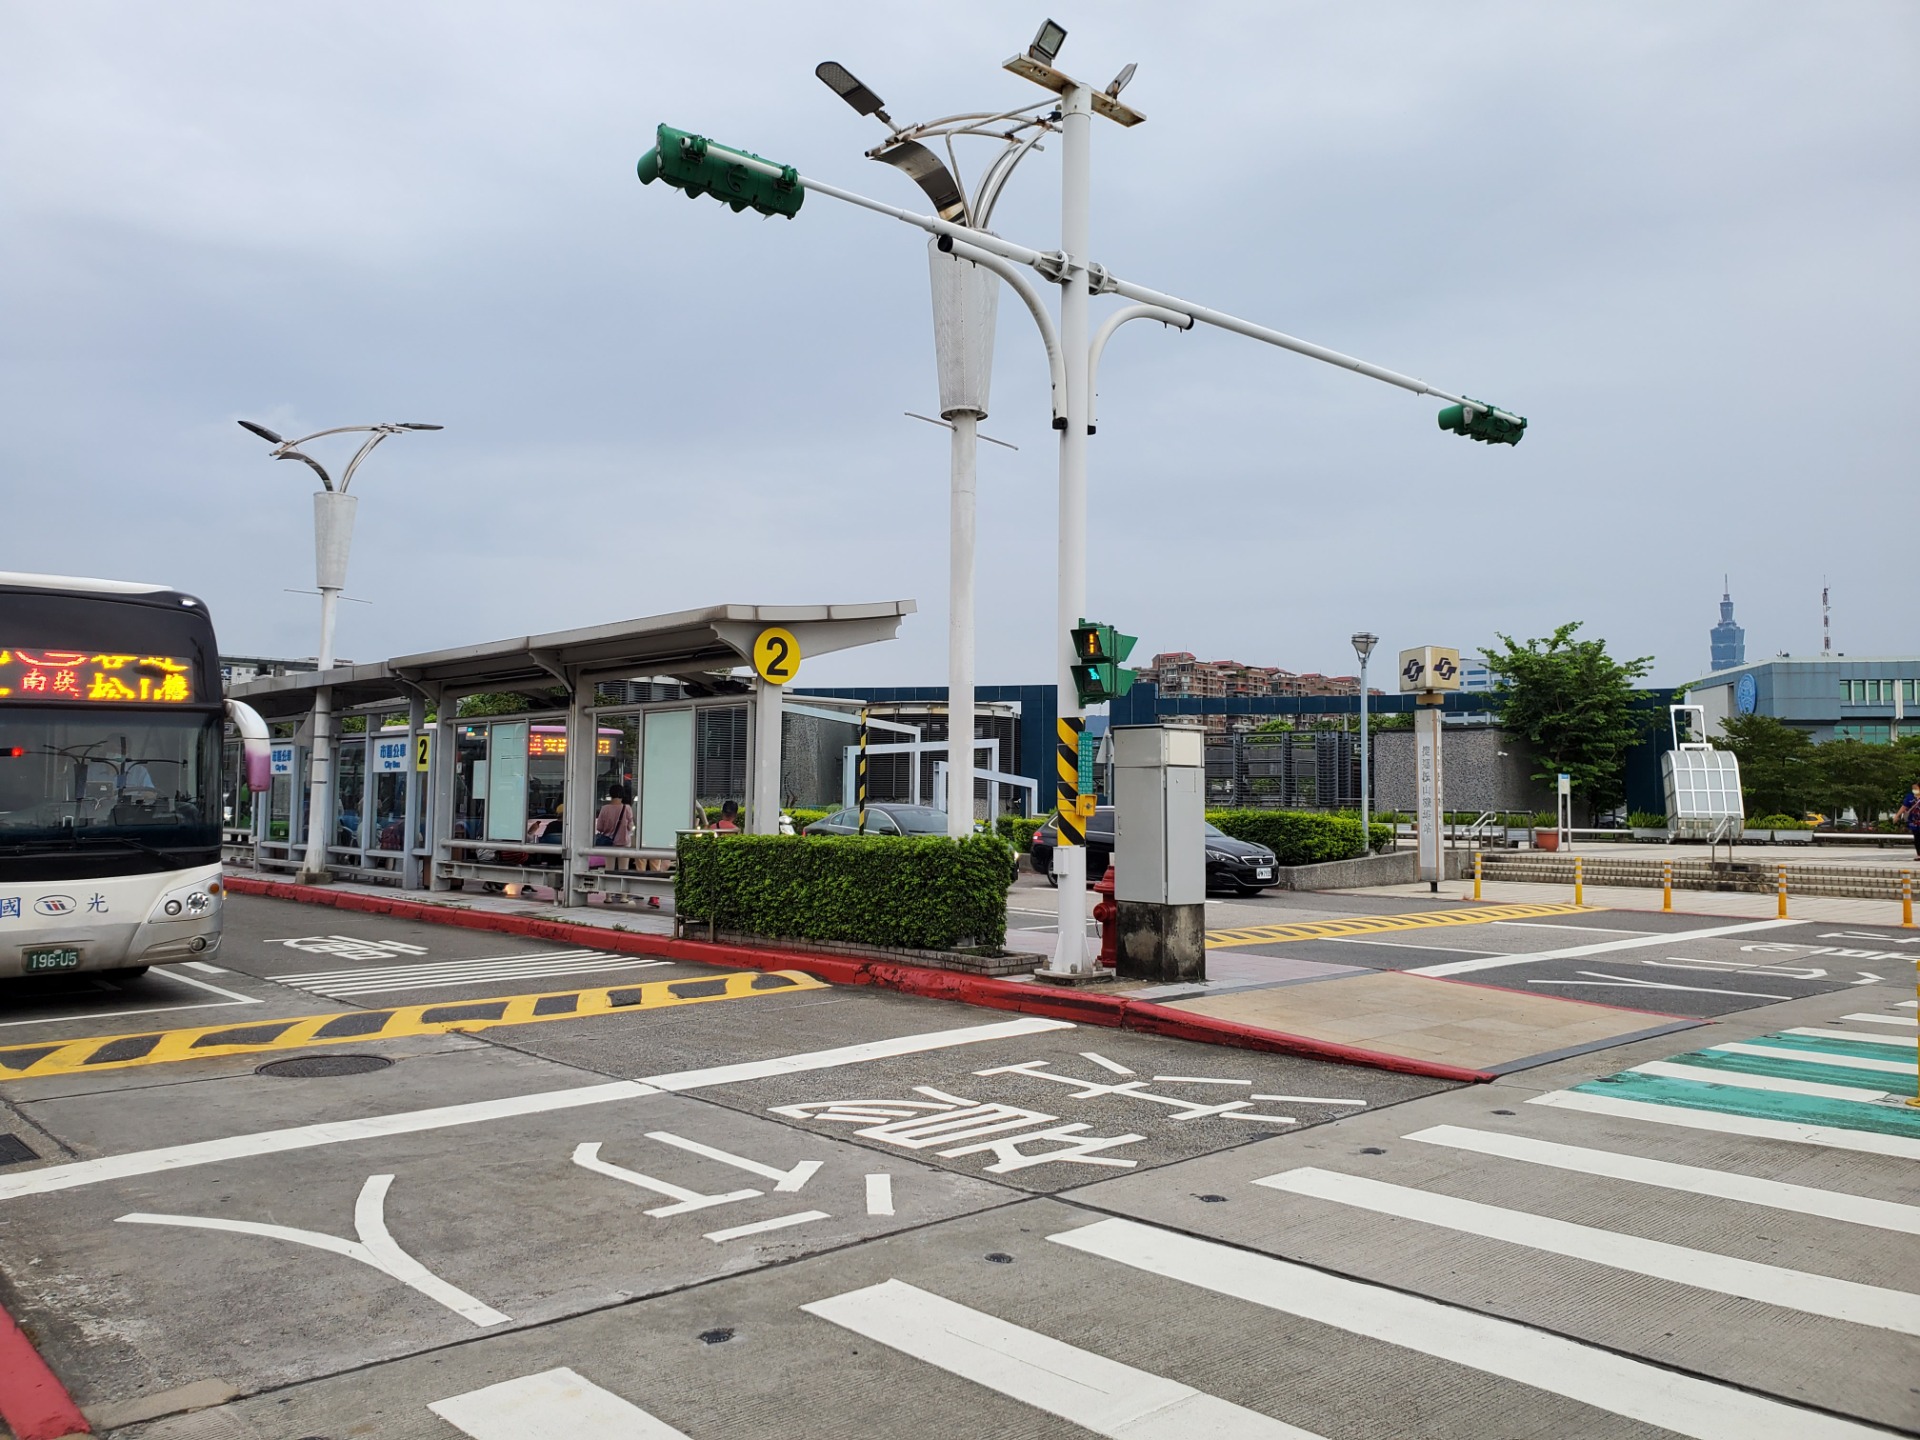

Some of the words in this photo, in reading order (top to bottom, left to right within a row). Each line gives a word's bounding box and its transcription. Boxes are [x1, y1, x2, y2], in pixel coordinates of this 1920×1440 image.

[766, 636, 789, 677] 2
[418, 738, 428, 765] 2
[31, 952, 77, 969] 196-U5
